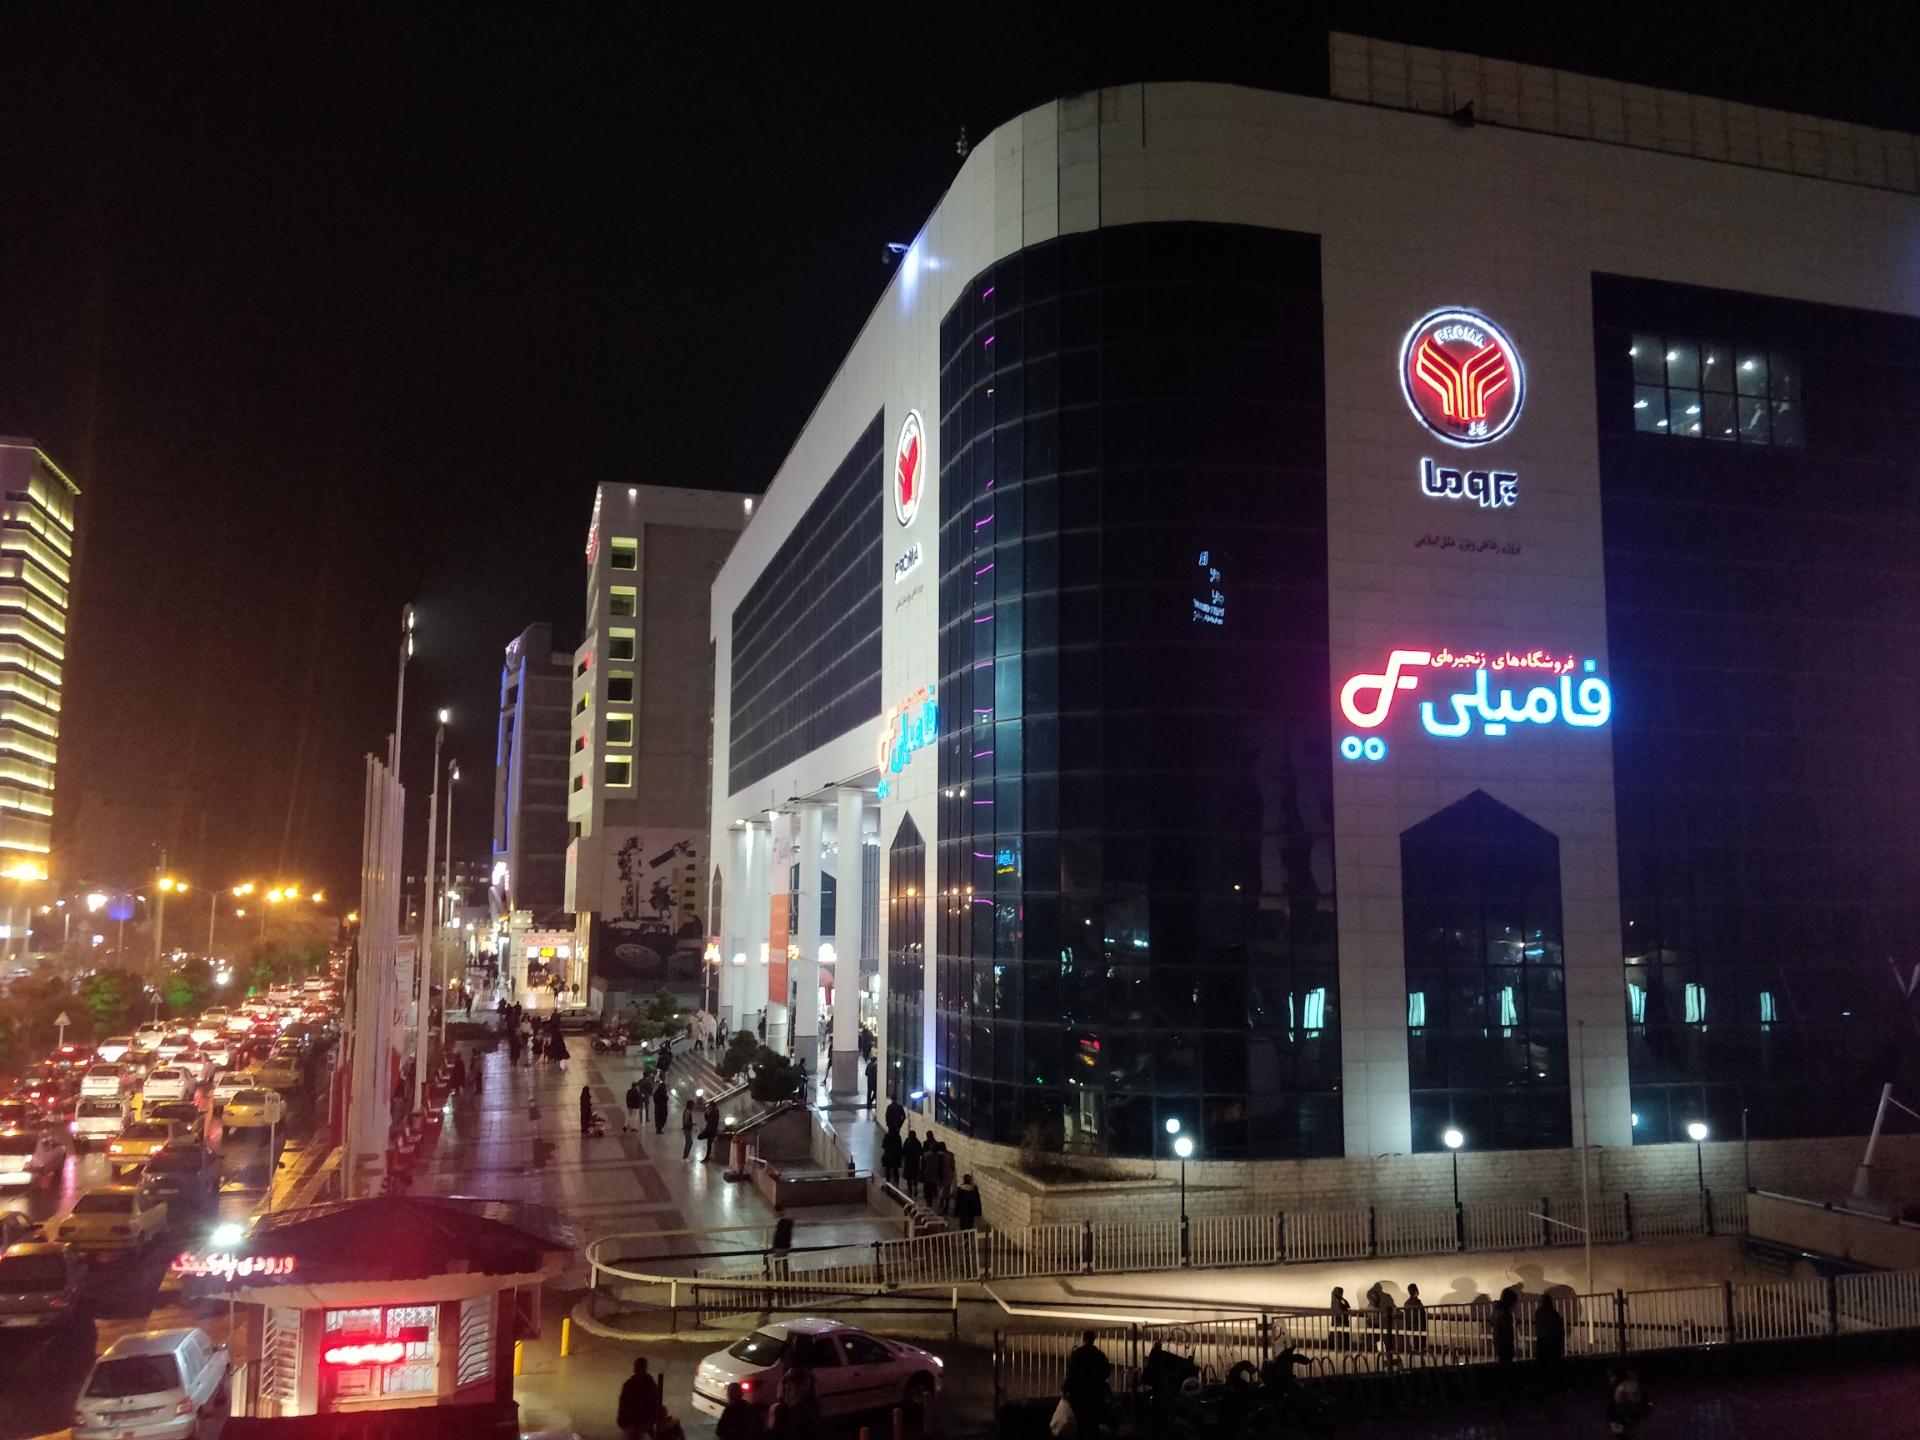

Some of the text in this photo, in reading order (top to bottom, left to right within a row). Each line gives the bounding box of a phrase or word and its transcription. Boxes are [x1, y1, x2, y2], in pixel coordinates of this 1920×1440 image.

[1433, 324, 1486, 349] PROMA
[1420, 456, 1519, 508] پروما
[1420, 659, 1612, 738] فامیلی
[171, 1250, 296, 1282] ورودی پارکینگ
